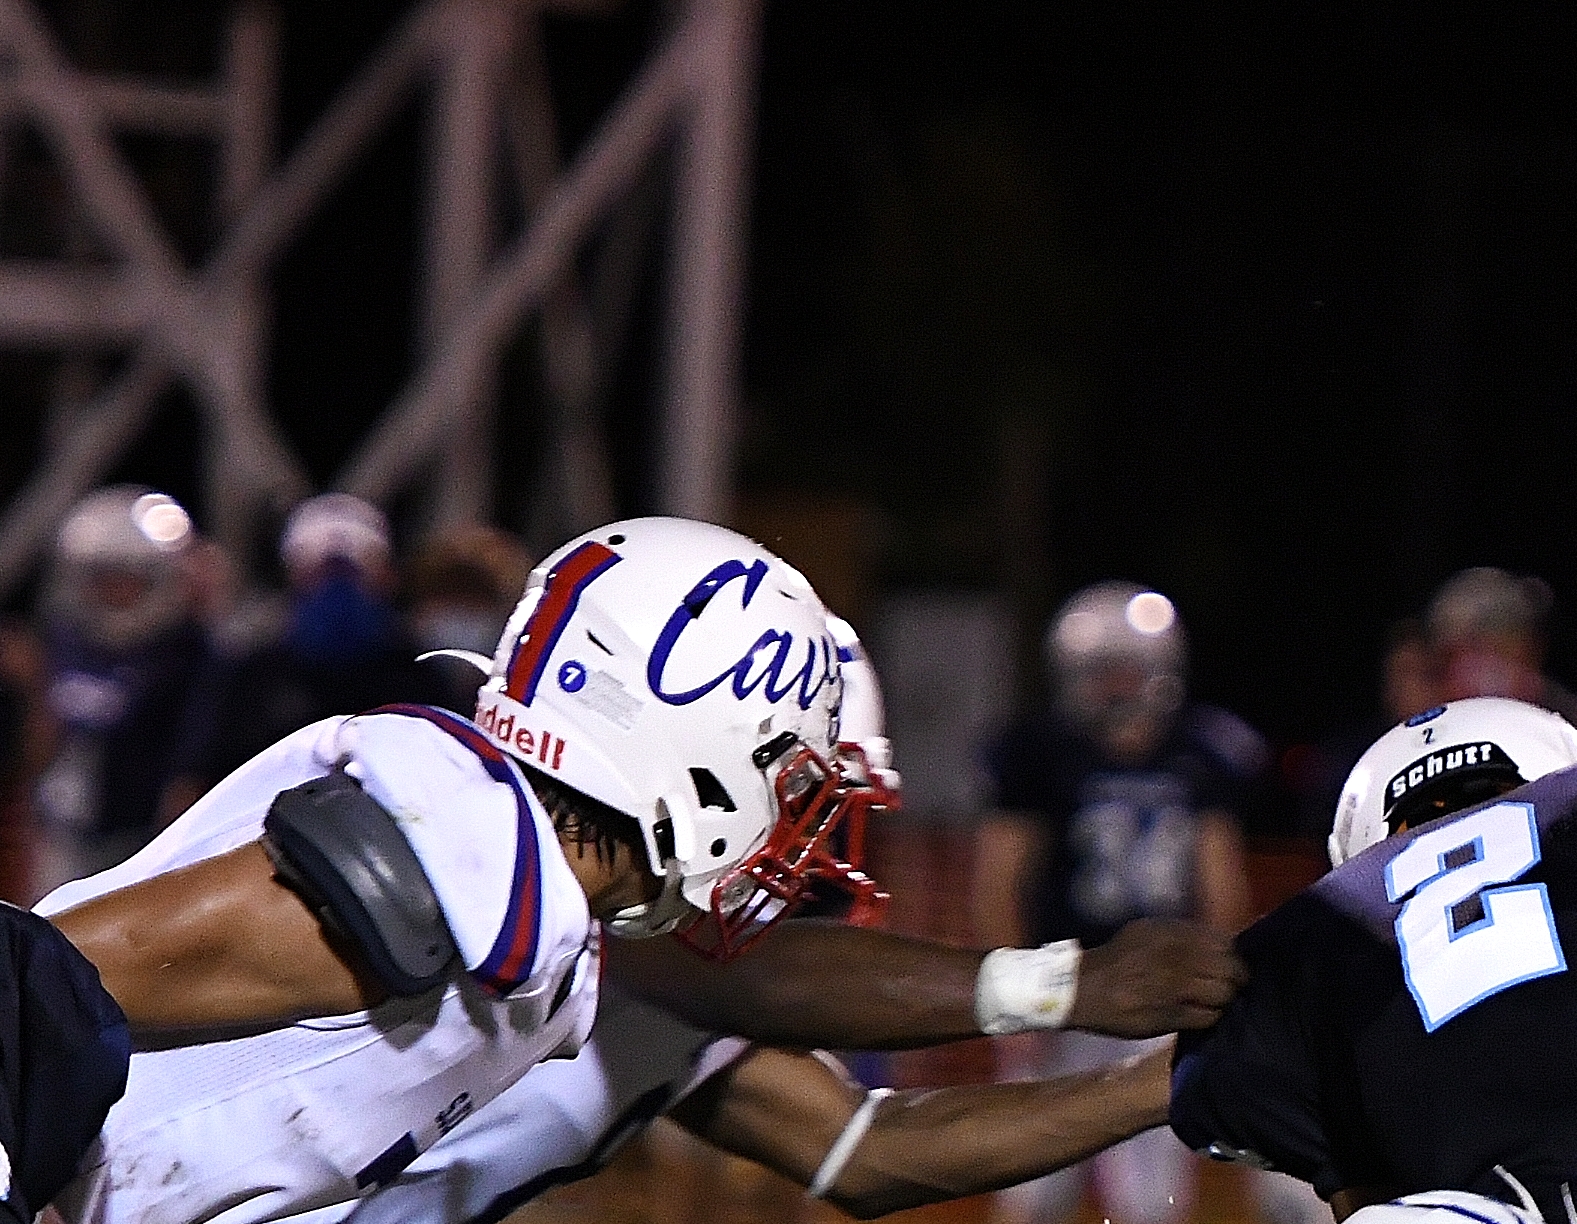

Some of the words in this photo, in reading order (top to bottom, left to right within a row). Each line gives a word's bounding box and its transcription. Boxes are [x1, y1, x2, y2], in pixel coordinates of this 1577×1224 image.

[563, 666, 582, 685] 7
[1422, 727, 1435, 745] 2
[1385, 800, 1569, 1034] 2
